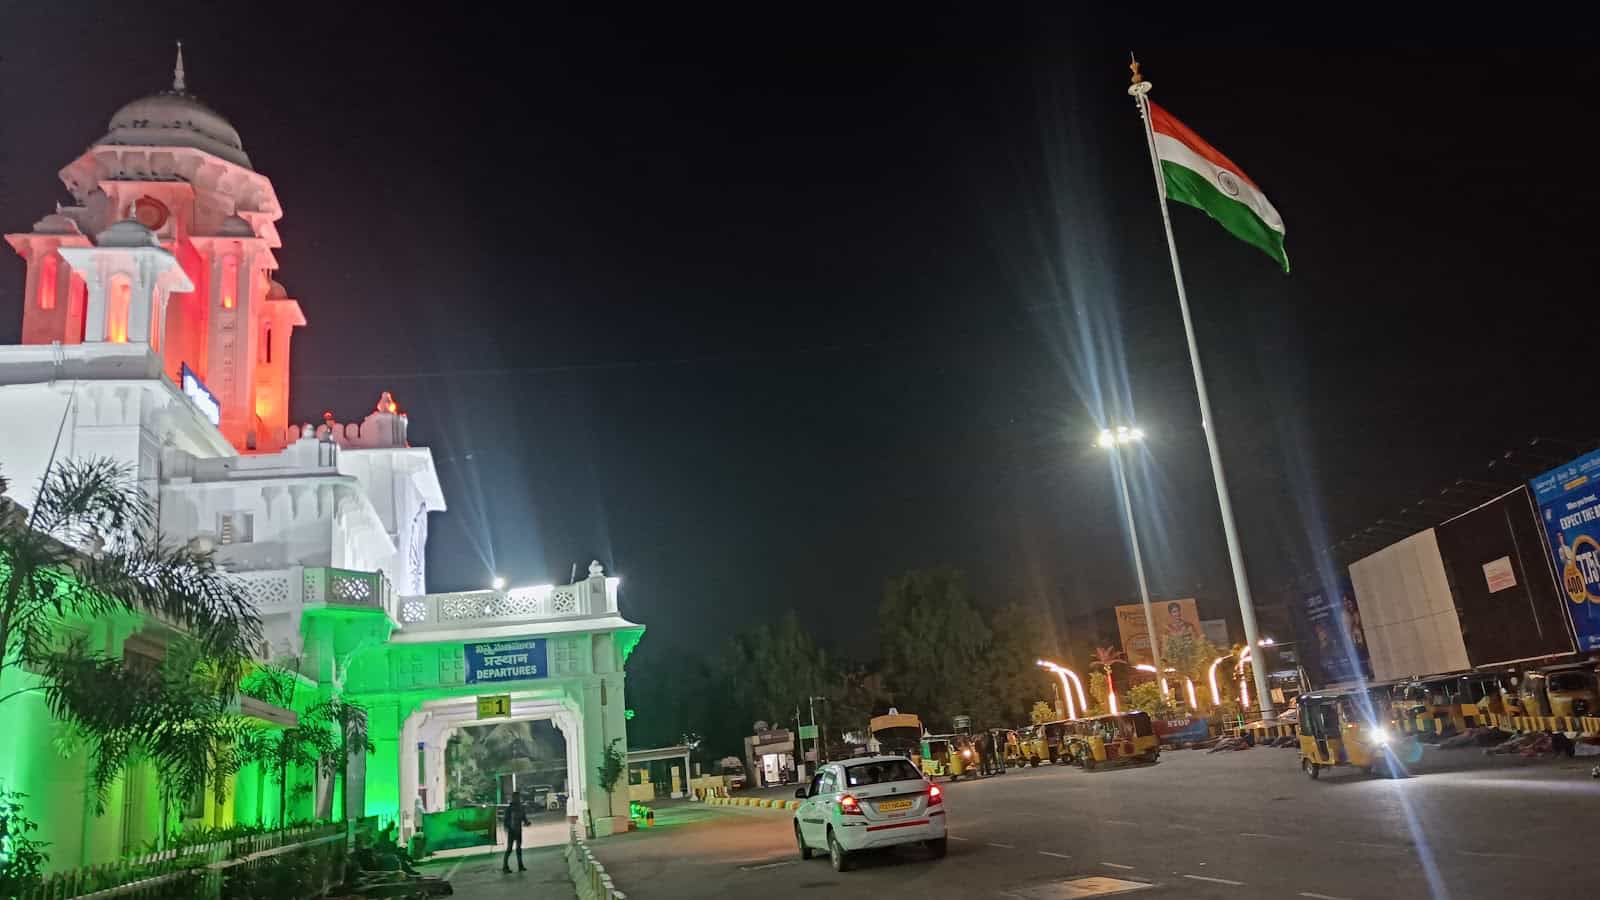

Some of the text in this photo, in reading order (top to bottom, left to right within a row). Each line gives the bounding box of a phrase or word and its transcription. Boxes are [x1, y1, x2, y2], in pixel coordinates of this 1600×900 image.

[1560, 512, 1582, 530] EXPECT
[1581, 507, 1596, 522] THE
[1567, 575, 1584, 593] 400
[484, 653, 528, 666] प्रस्थान
[476, 665, 537, 680] DEPARTURES
[495, 698, 506, 715] 1
[1167, 719, 1191, 728] STOP
